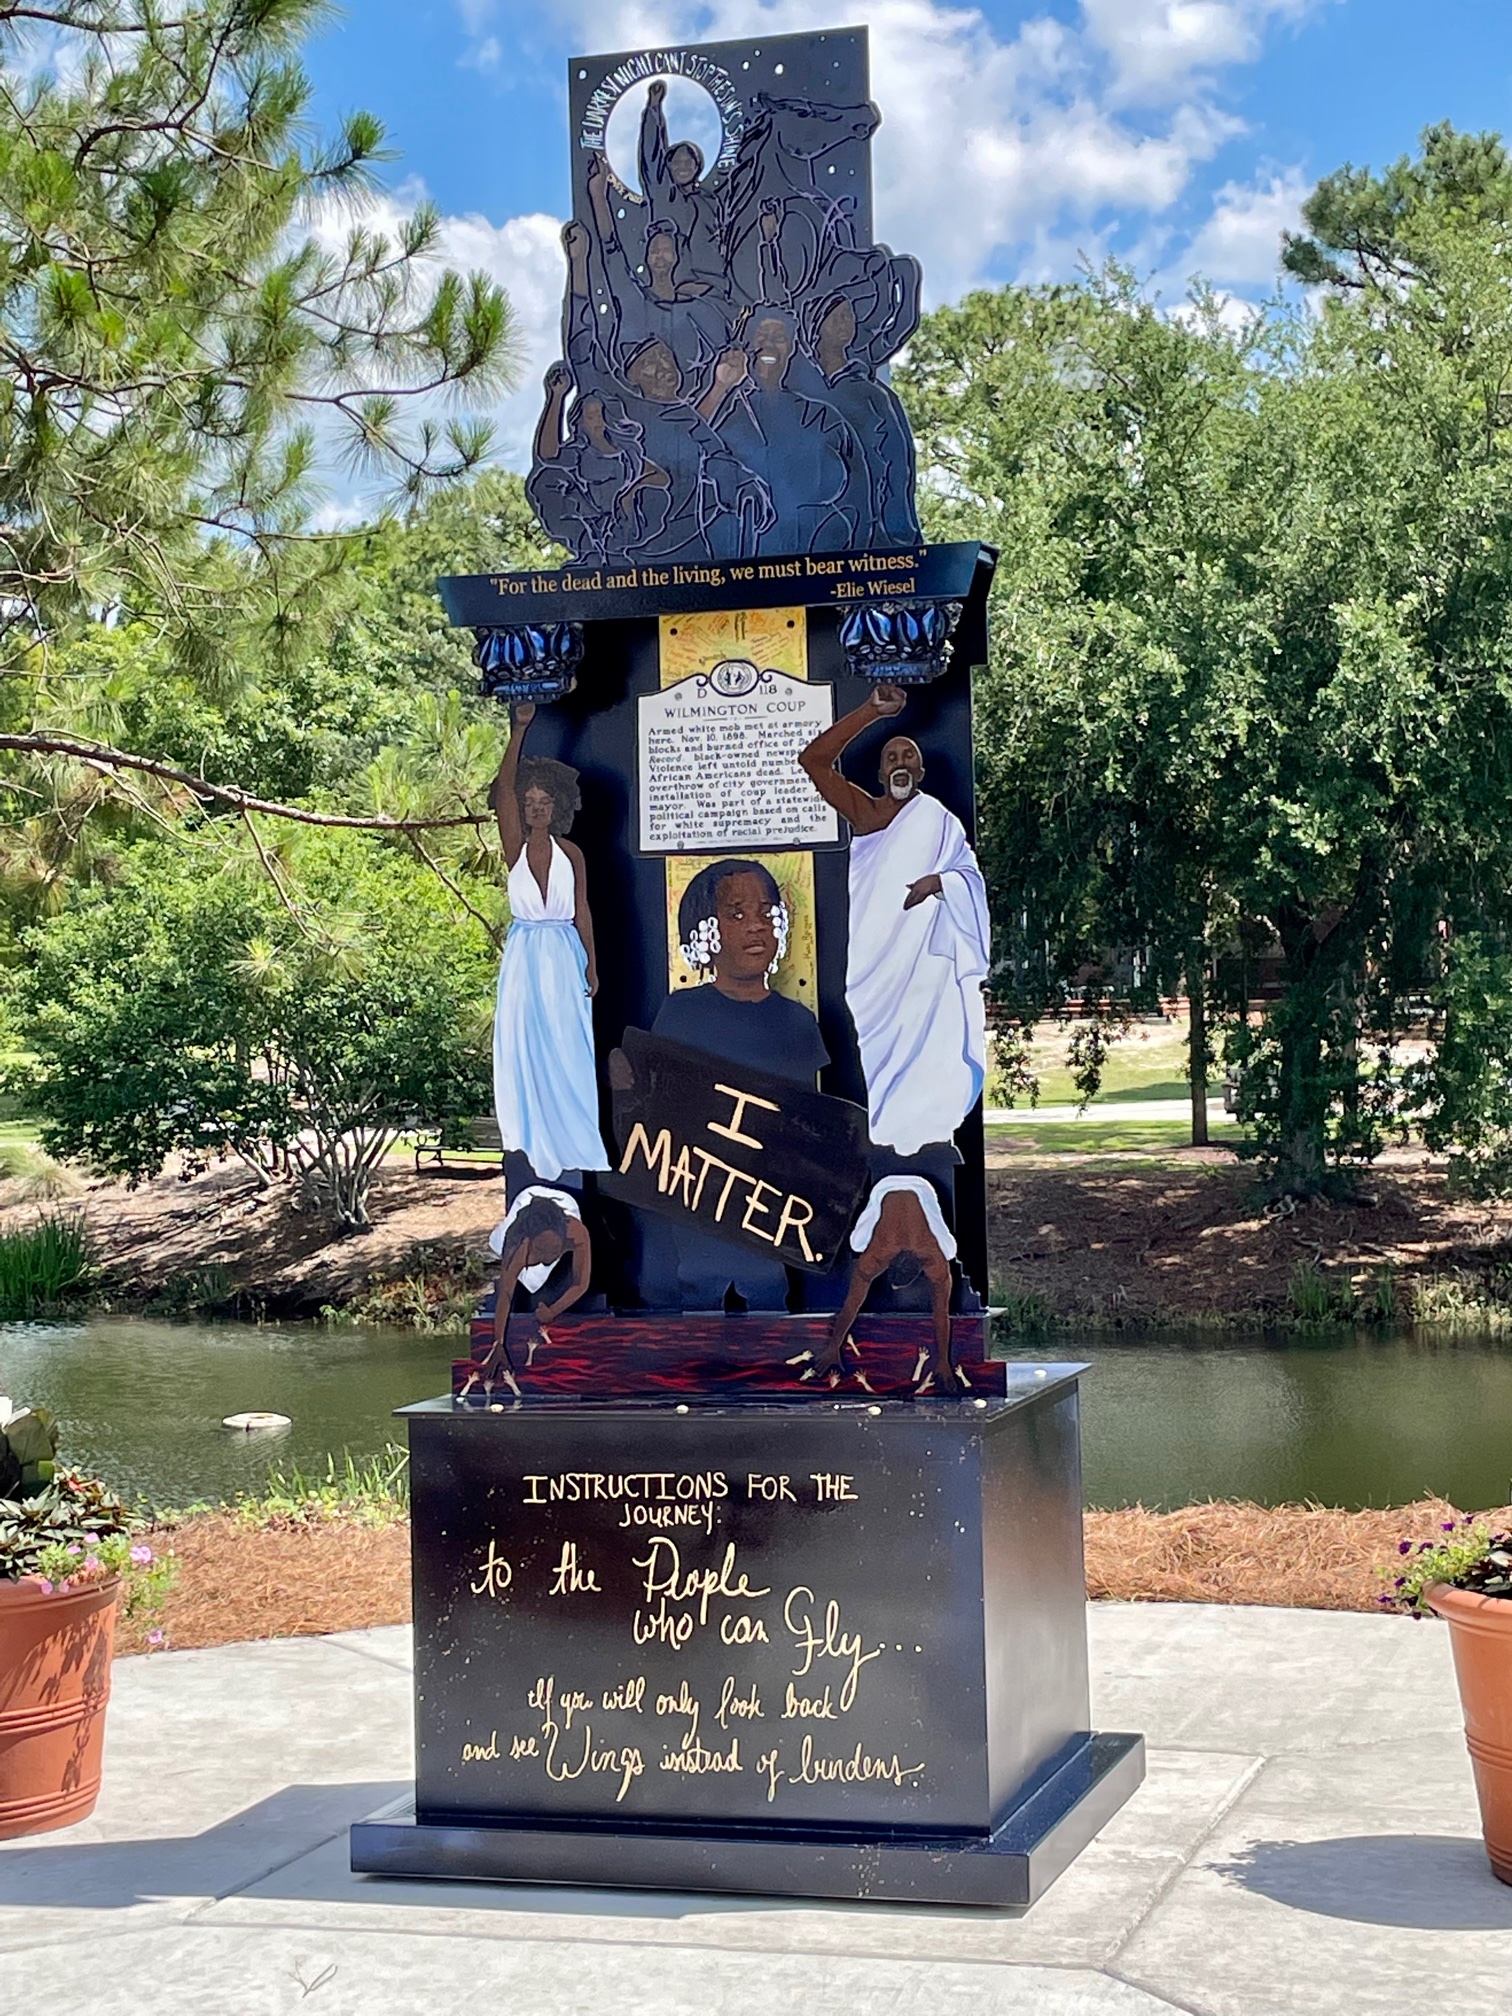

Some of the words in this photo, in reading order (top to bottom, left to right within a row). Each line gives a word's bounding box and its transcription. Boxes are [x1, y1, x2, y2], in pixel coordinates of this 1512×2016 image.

[580, 129, 605, 150] THE
[614, 52, 653, 86] NIGHT
[717, 125, 744, 168] SHINE
[490, 578, 527, 595] "For
[531, 577, 557, 593] the
[562, 571, 601, 592] dead
[606, 569, 637, 589] and
[642, 568, 669, 587] the
[673, 565, 726, 586] living,
[730, 567, 754, 580] we
[758, 560, 801, 579] must
[805, 557, 845, 576] bear
[848, 549, 927, 572] witness."
[830, 583, 865, 598] -Elie
[867, 577, 915, 596] Wiesel
[697, 688, 707, 699] D
[759, 684, 777, 695] 118
[664, 704, 758, 718] WILMINGTON
[766, 701, 806, 713] COUP
[648, 726, 684, 736] Armed
[689, 725, 716, 733] white
[720, 723, 741, 732] mob
[744, 722, 763, 730] met
[768, 721, 778, 729] at
[782, 720, 822, 728] armory
[758, 729, 803, 738] Marched
[648, 745, 681, 754] blocks
[684, 744, 703, 752] and
[706, 741, 743, 751] burned
[747, 740, 778, 748] office
[694, 750, 759, 761] black-owned
[649, 764, 693, 773] Violence
[698, 761, 717, 770] left
[722, 760, 756, 769] untold
[649, 773, 691, 782] African
[696, 770, 751, 780] Americans
[756, 768, 783, 776] dead.
[649, 783, 704, 792] overthrow
[708, 780, 720, 789] of
[723, 780, 745, 789] city
[649, 792, 712, 801] installation
[720, 789, 732, 797] of
[741, 789, 766, 797] coup
[774, 786, 807, 794] leader
[696, 800, 716, 808] Was
[722, 799, 745, 809] part
[750, 797, 761, 805] of
[649, 810, 694, 822] political
[698, 809, 748, 819] campaign
[752, 805, 782, 815] based
[802, 804, 826, 812] calls
[649, 822, 666, 831] for
[675, 820, 704, 829] white
[713, 817, 771, 829] supremacy
[781, 815, 800, 823] and
[810, 814, 827, 822] the
[649, 831, 713, 842] exploitation
[716, 829, 728, 837] of
[732, 827, 761, 836] racial
[707, 1083, 781, 1150] I
[618, 1122, 823, 1262] MATTER.
[522, 1472, 728, 1504] INSTRUCTIONS
[748, 1473, 797, 1502] FOR
[810, 1472, 858, 1501] THE
[619, 1501, 722, 1535] JOURNEY:
[470, 1538, 512, 1598] to
[549, 1541, 602, 1595] the
[632, 1536, 771, 1625] People
[633, 1597, 693, 1650] who
[720, 1613, 770, 1645] can
[560, 1692, 594, 1730] you
[602, 1676, 646, 1714] will
[655, 1680, 699, 1750] only
[714, 1676, 765, 1730] look
[781, 1681, 838, 1719] back
[461, 1730, 501, 1761] and
[509, 1735, 540, 1759] see
[541, 1721, 646, 1802] Wings
[659, 1736, 743, 1774] instead
[756, 1749, 785, 1803] of
